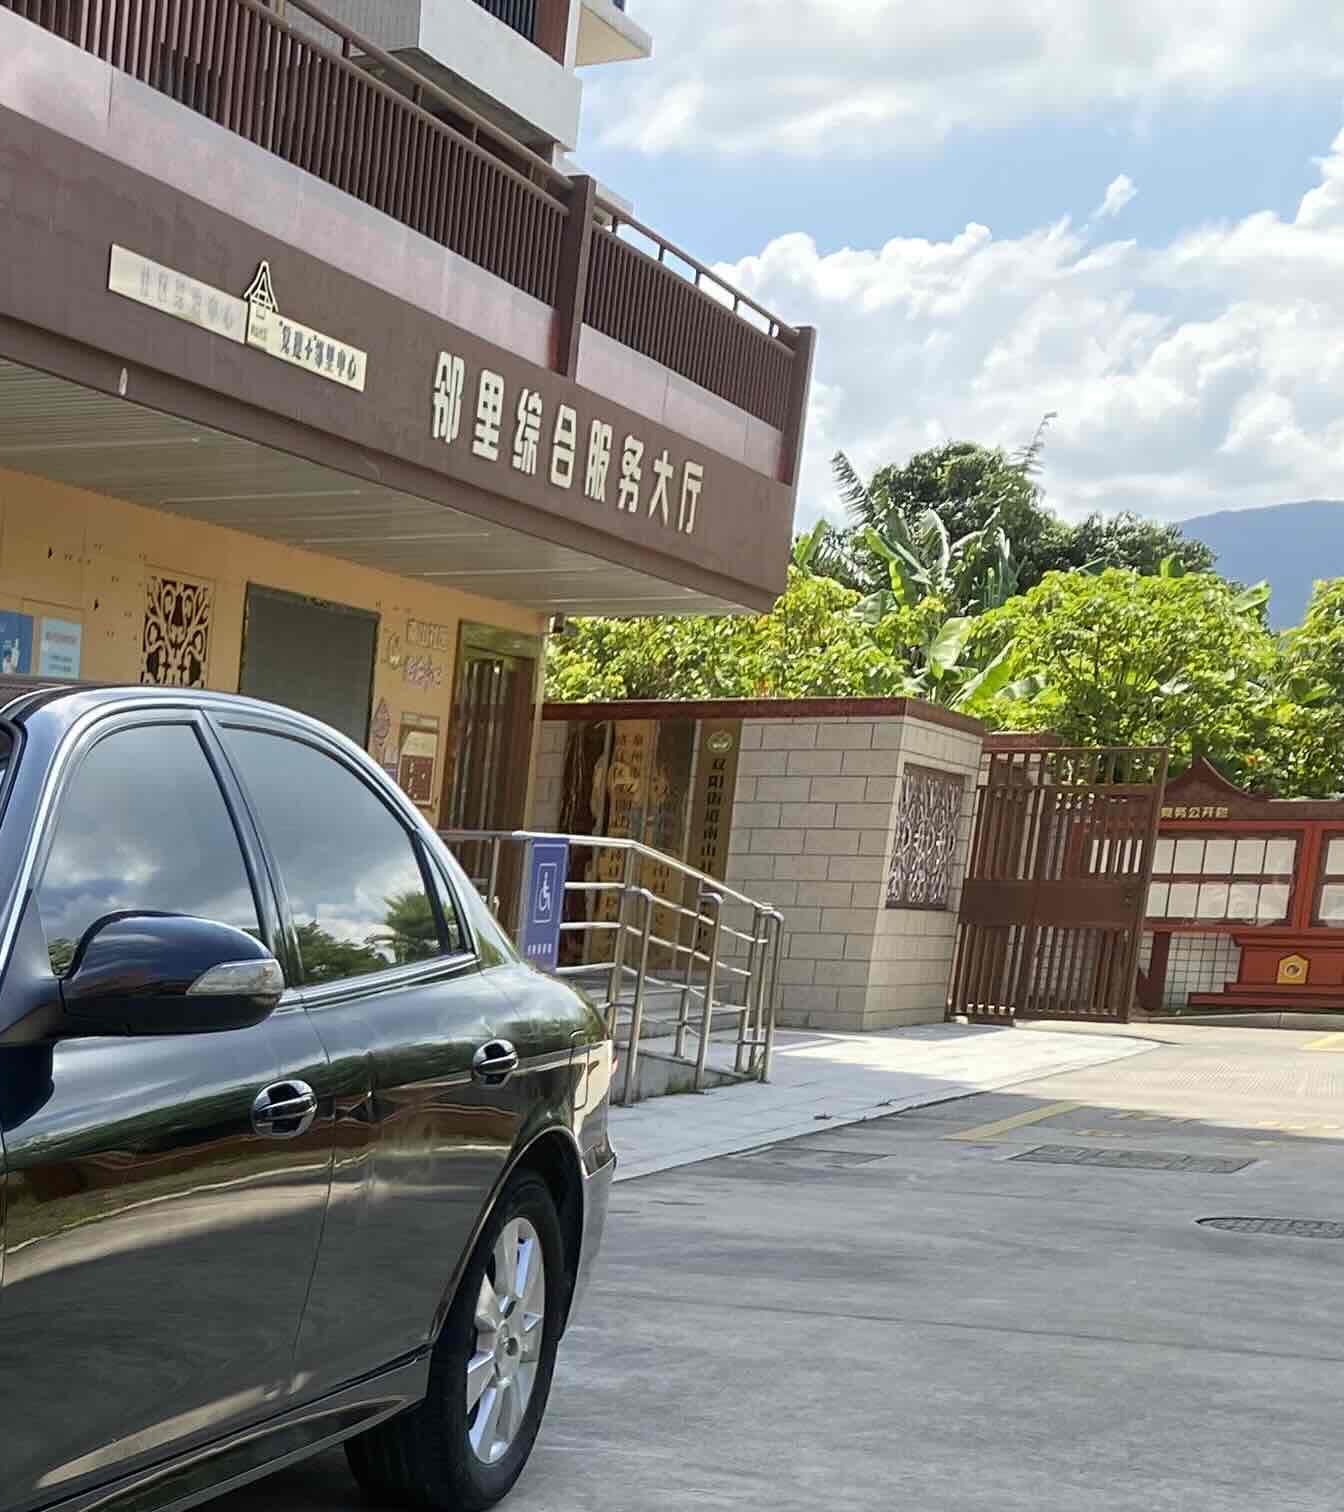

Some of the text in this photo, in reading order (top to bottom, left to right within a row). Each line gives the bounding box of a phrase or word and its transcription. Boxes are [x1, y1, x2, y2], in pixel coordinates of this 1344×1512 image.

[432, 351, 705, 534] 邻里综合服务大厅
